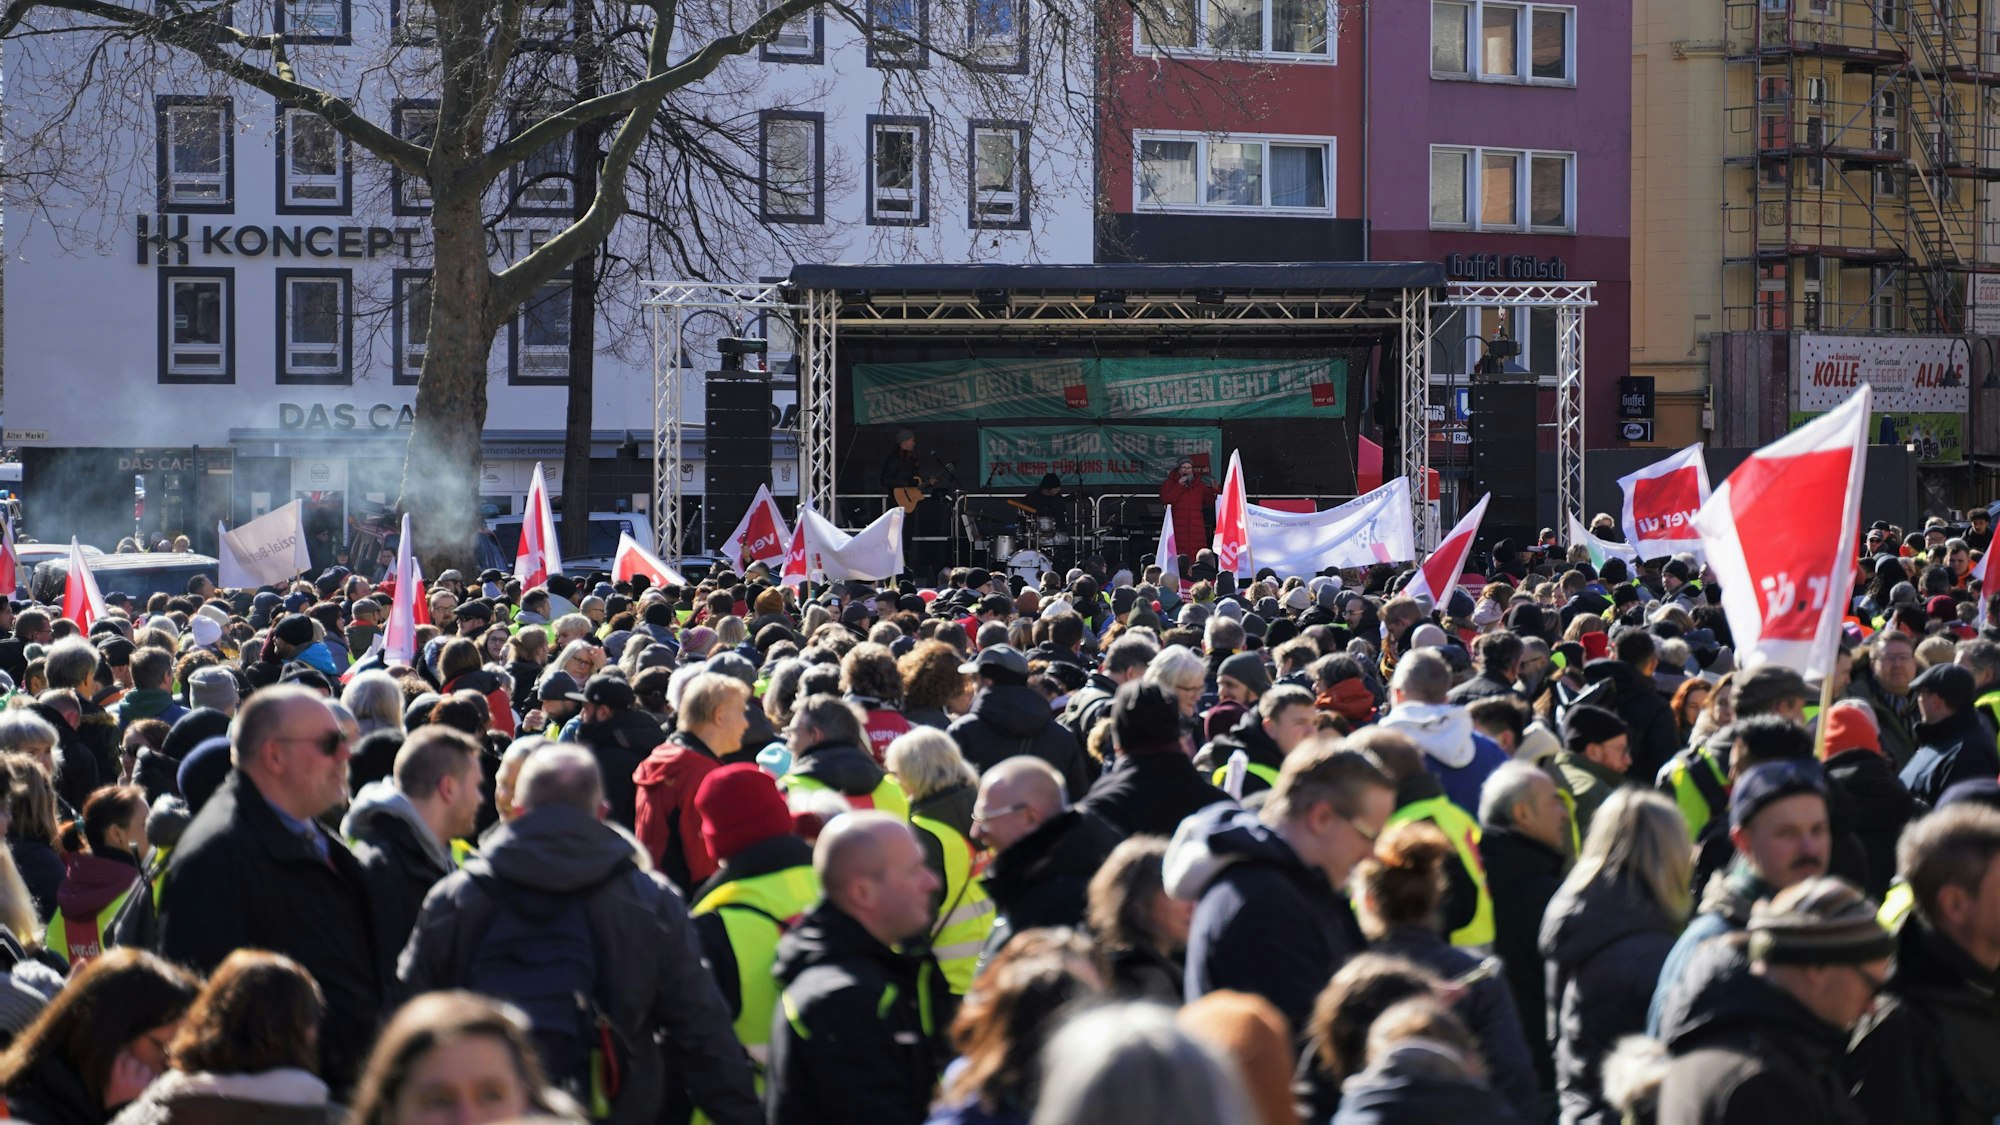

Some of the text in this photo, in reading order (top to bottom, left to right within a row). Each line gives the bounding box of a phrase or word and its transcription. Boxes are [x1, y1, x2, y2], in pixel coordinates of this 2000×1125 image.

[203, 225, 420, 258] KONCEPT
[1447, 253, 1567, 281] Gaffel Kölsch
[1875, 358, 1900, 366] Gerüstbau
[1915, 362, 1964, 389] ALAF
[866, 381, 971, 418] ZUSAMMEN
[974, 371, 1024, 400] GEHT
[1107, 364, 1332, 411] ZUSAMMEN GEHT MEHR
[1622, 394, 1646, 407] Gaffel
[279, 403, 356, 430] DAS
[6, 431, 45, 440] Alter Markt
[481, 446, 526, 455] omemade
[1172, 438, 1213, 456] MEHR
[119, 458, 154, 470] DAS
[1016, 461, 1048, 476] MEHR
[1052, 458, 1077, 475] FÜR
[1080, 460, 1103, 473] UNS
